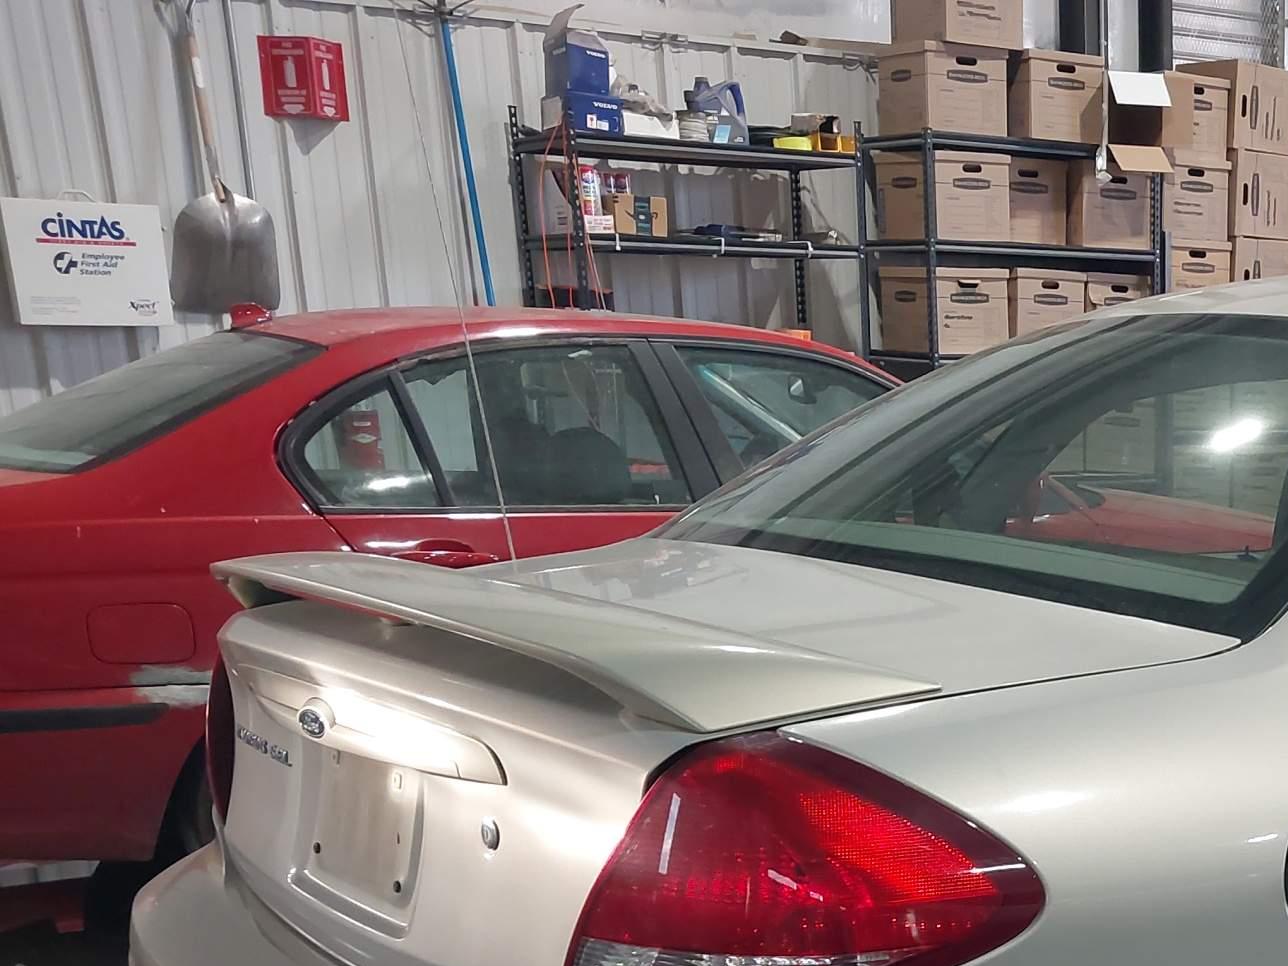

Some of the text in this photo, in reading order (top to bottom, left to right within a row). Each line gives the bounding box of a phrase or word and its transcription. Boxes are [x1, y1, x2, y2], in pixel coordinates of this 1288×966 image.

[592, 101, 618, 110] VOLVO
[81, 252, 125, 262] Employee
[80, 260, 100, 268] First
